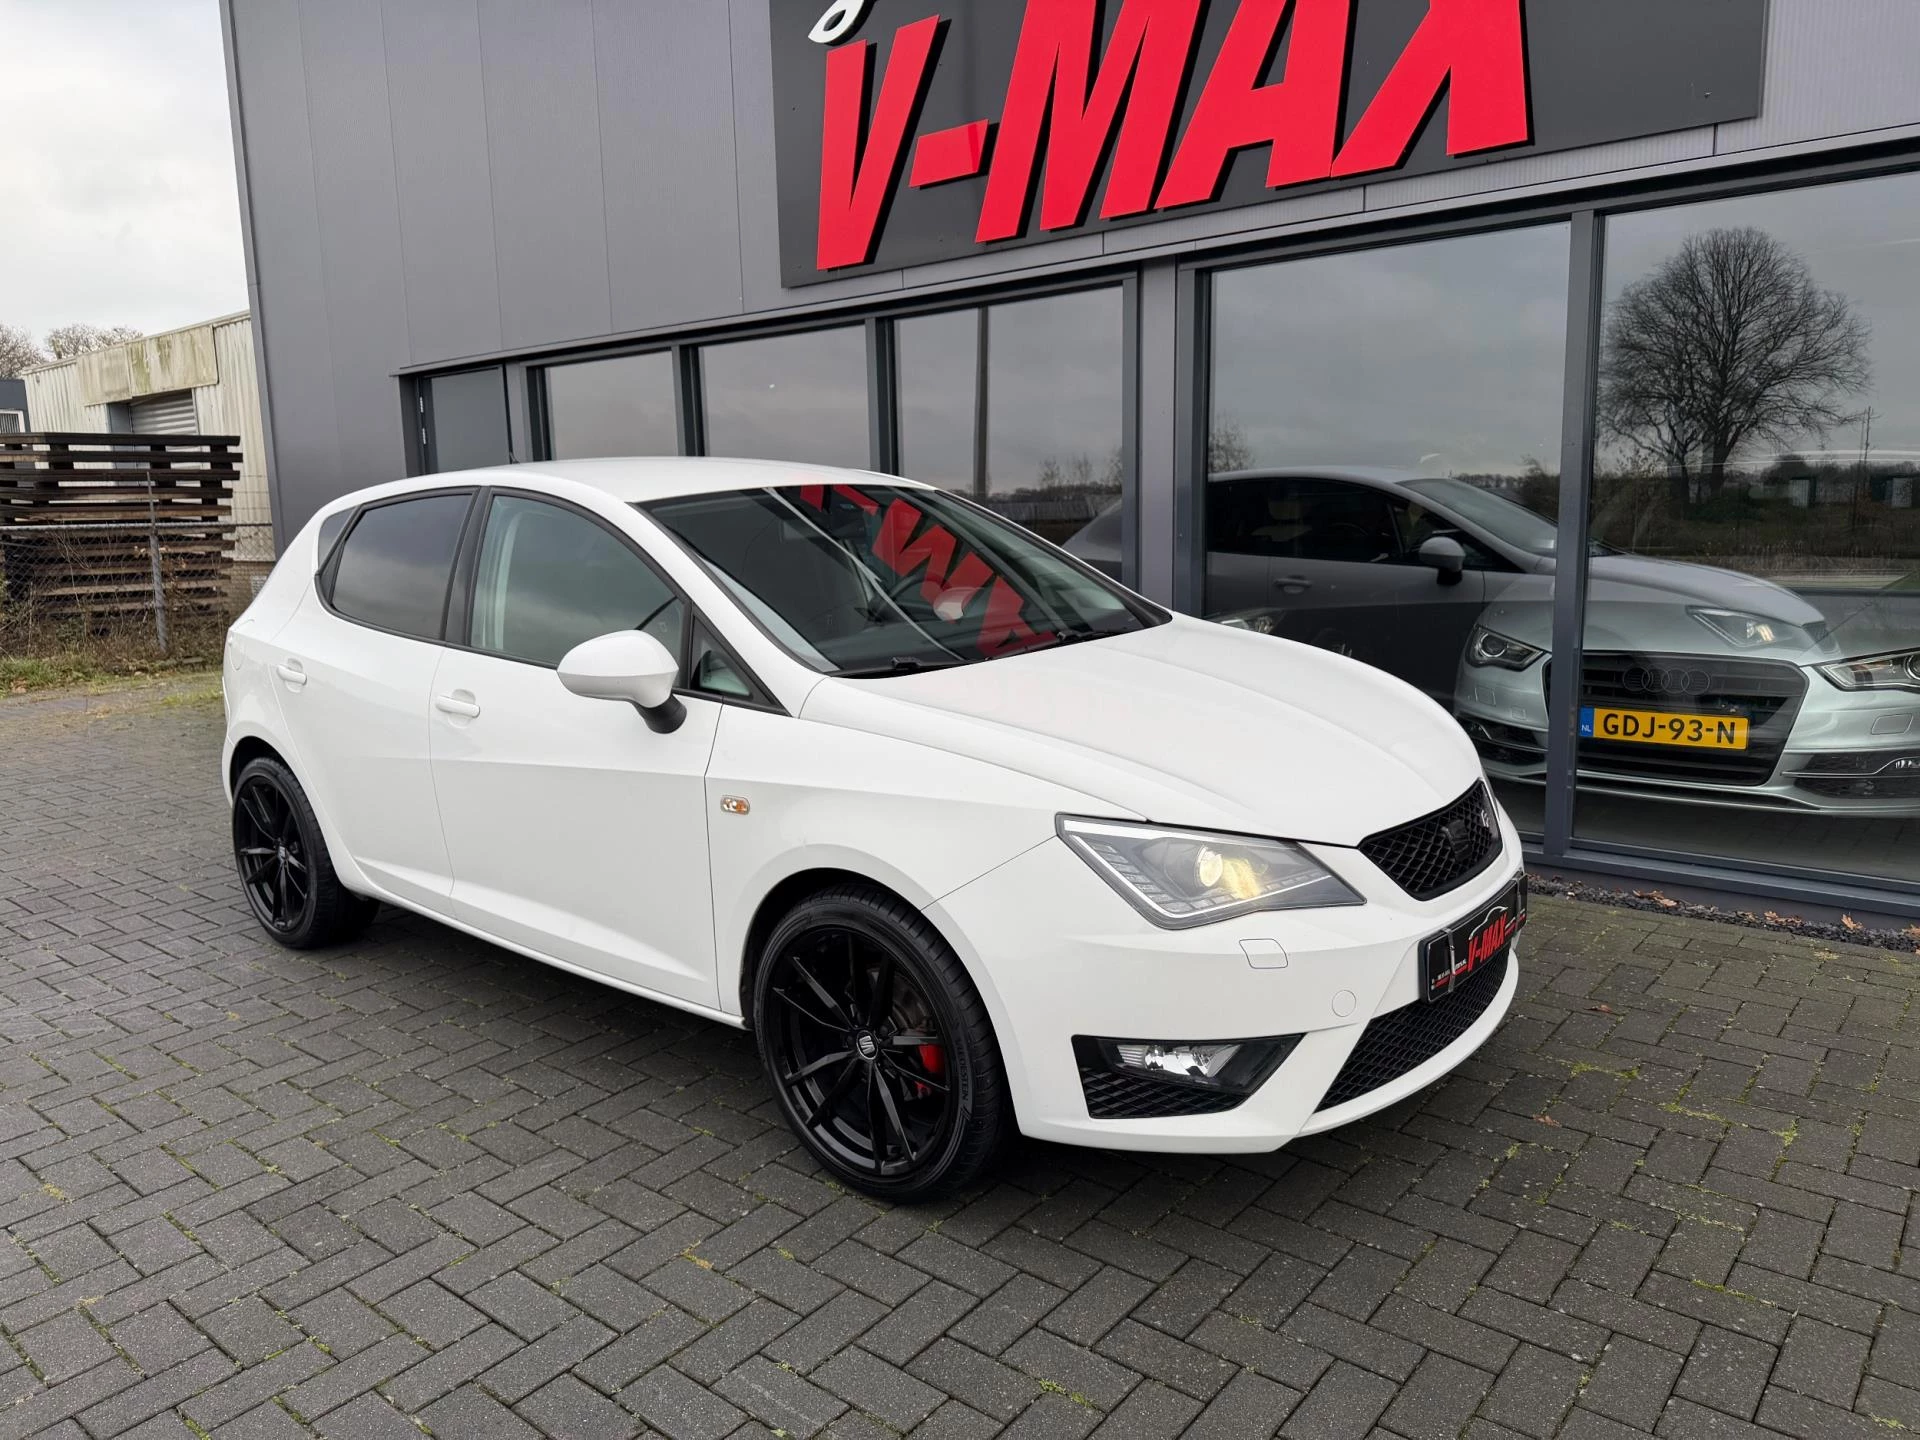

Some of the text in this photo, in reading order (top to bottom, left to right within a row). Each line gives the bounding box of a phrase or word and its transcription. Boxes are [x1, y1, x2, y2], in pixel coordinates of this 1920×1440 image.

[817, 0, 1528, 270] V-MAX
[1581, 724, 1592, 732] NL
[1603, 713, 1736, 745] GDJ-93-N
[1467, 911, 1508, 973] V-MAX
